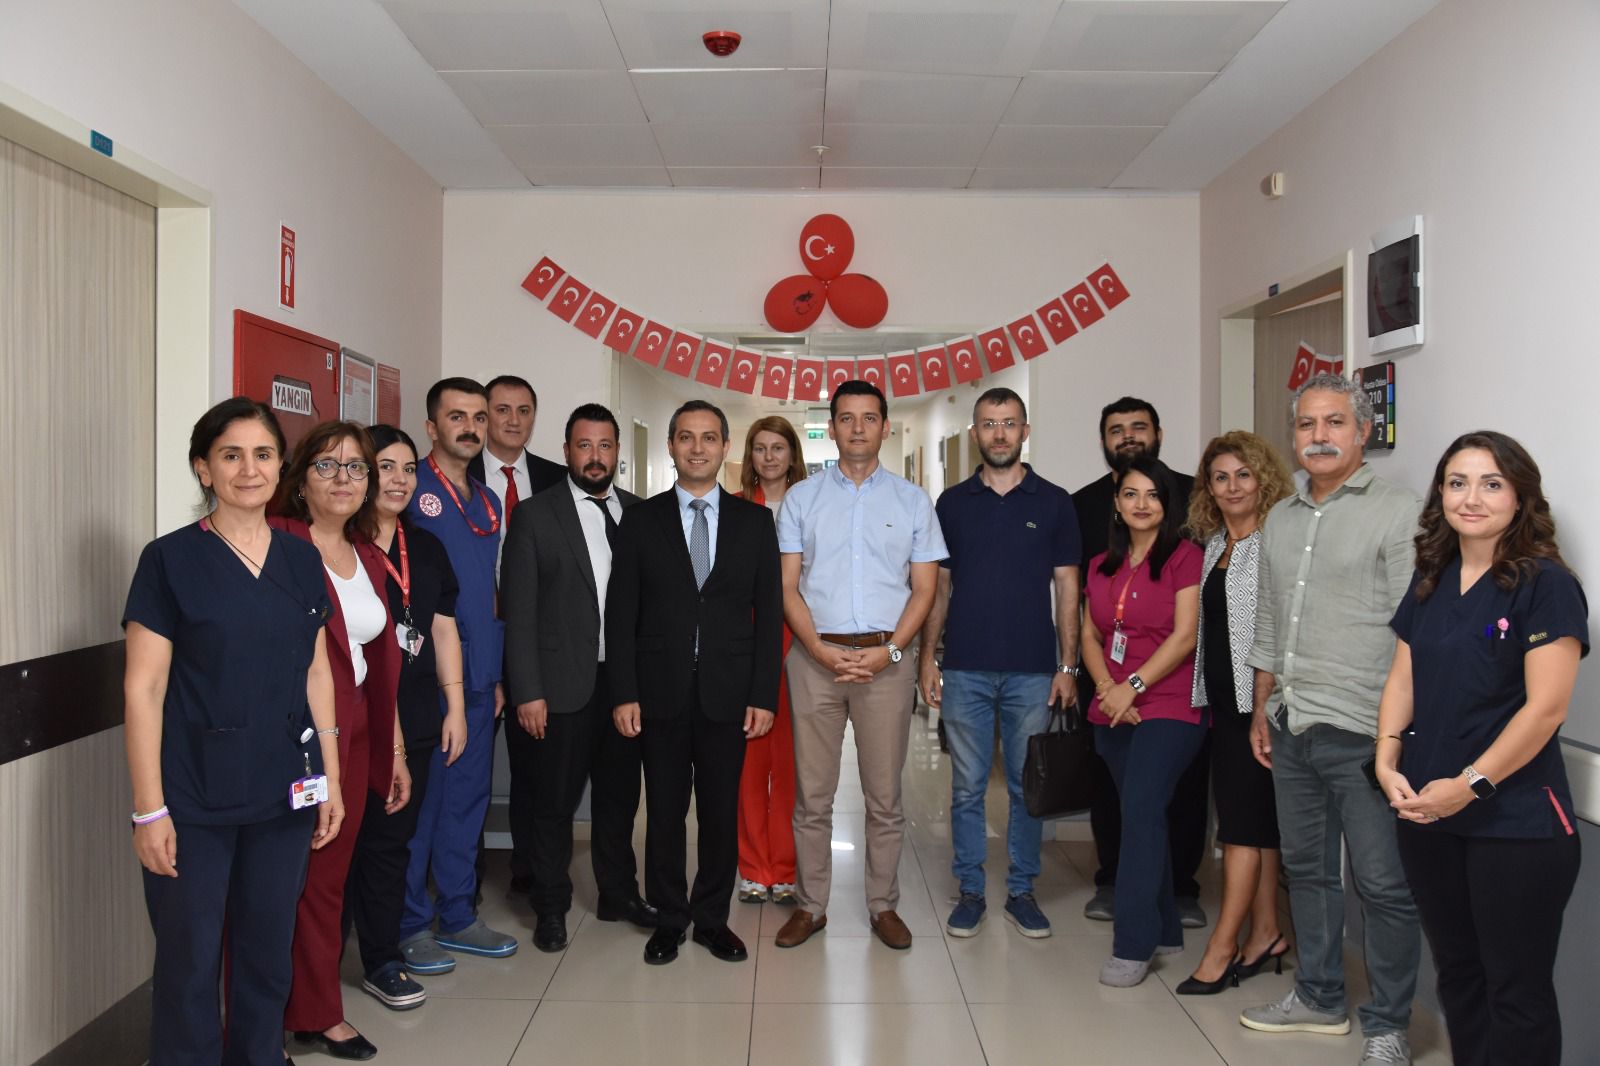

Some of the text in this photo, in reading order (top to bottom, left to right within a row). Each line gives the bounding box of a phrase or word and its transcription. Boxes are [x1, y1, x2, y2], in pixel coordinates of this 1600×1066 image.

[327, 355, 332, 368] 8
[274, 384, 310, 412] YANGIN
[1369, 390, 1382, 405] 210
[1378, 427, 1383, 441] 2
